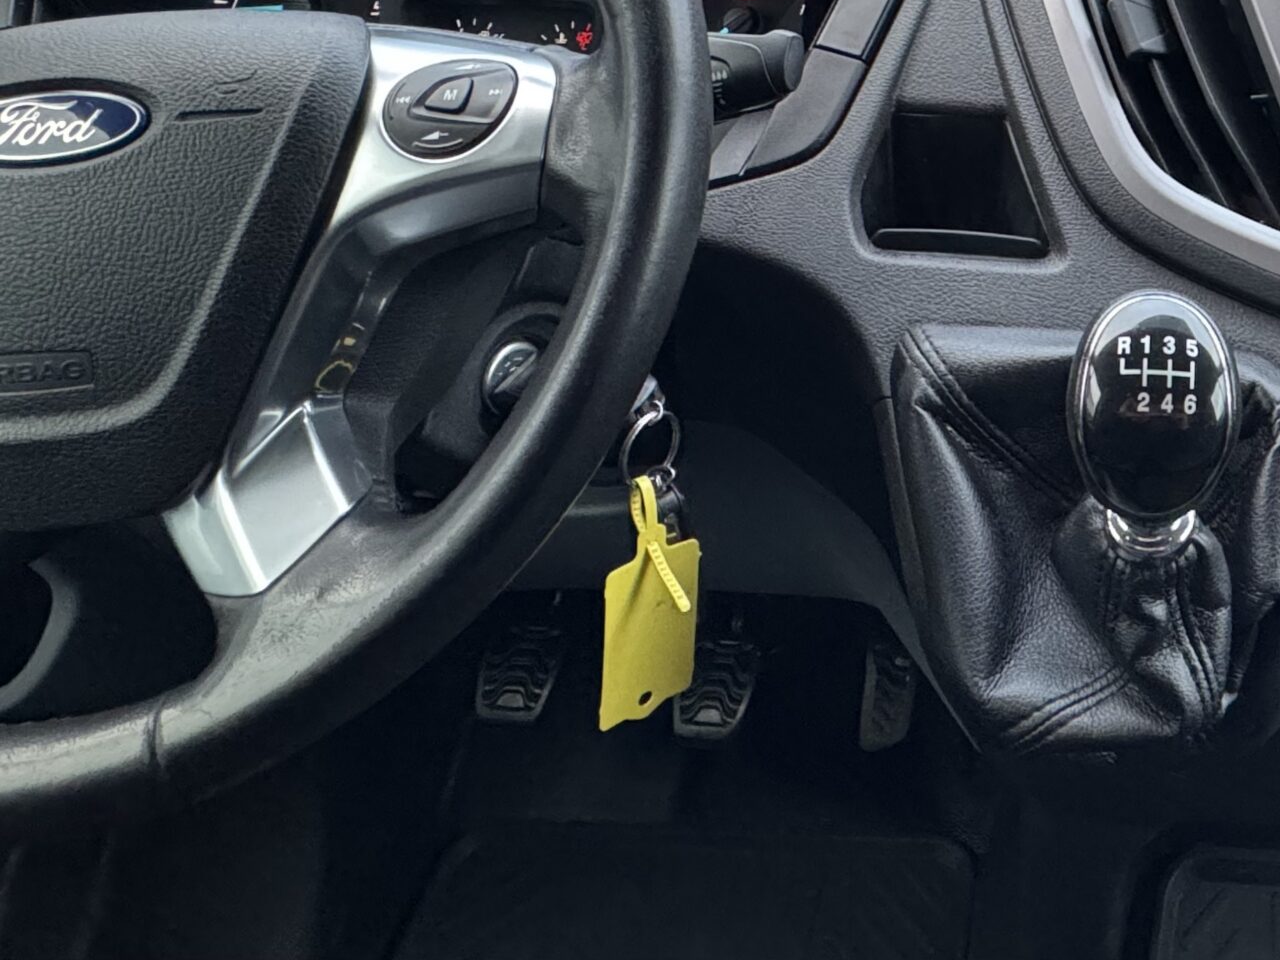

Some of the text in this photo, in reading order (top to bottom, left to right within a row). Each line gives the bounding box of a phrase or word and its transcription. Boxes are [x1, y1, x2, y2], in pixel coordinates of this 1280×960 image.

[443, 89, 458, 101] M
[0, 100, 103, 146] Ford
[1117, 334, 1199, 357] R 1 3 5
[1136, 392, 1197, 414] 2 4 6
